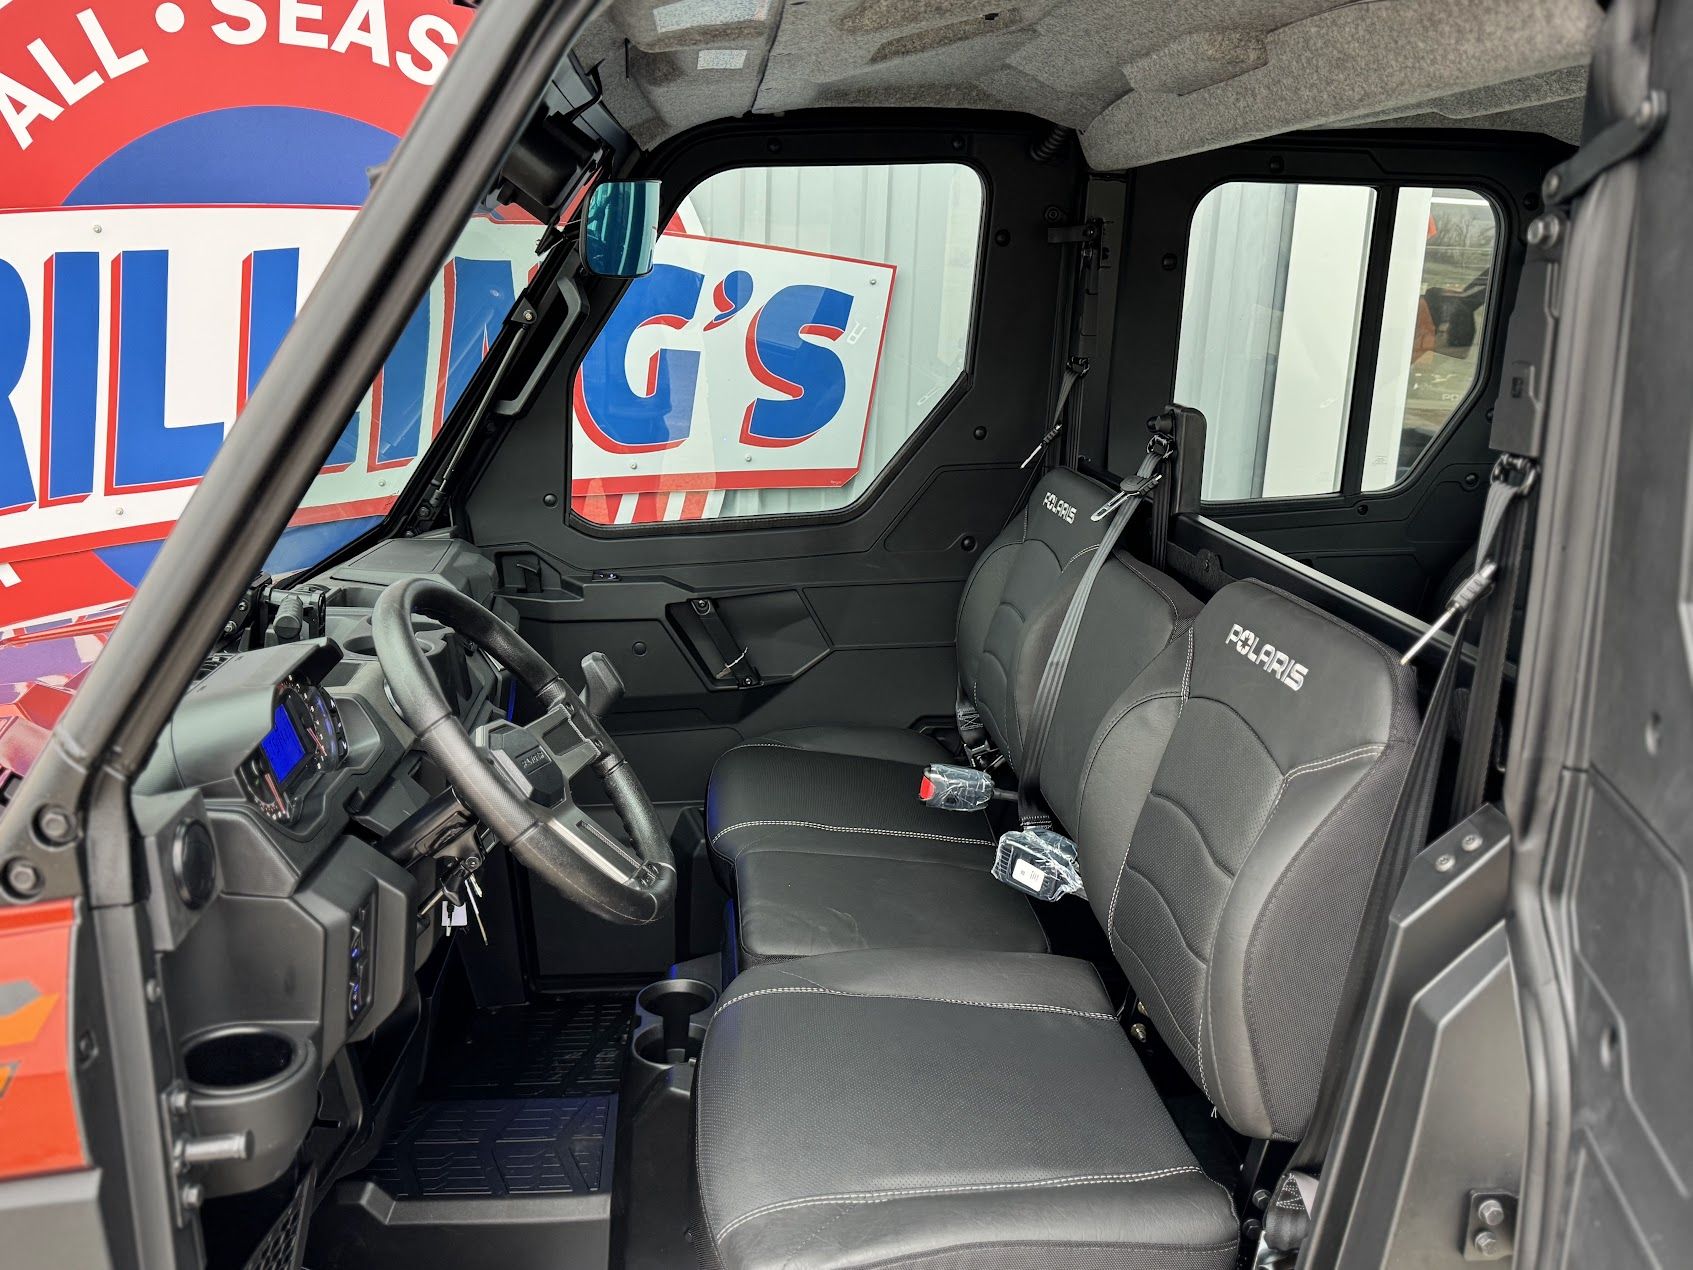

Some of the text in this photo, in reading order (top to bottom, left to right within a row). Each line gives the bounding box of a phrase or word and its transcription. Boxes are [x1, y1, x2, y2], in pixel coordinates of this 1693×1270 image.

[0, 8, 149, 150] ALL
[1042, 491, 1077, 524] POLARIS
[1225, 623, 1309, 692] POLARIS
